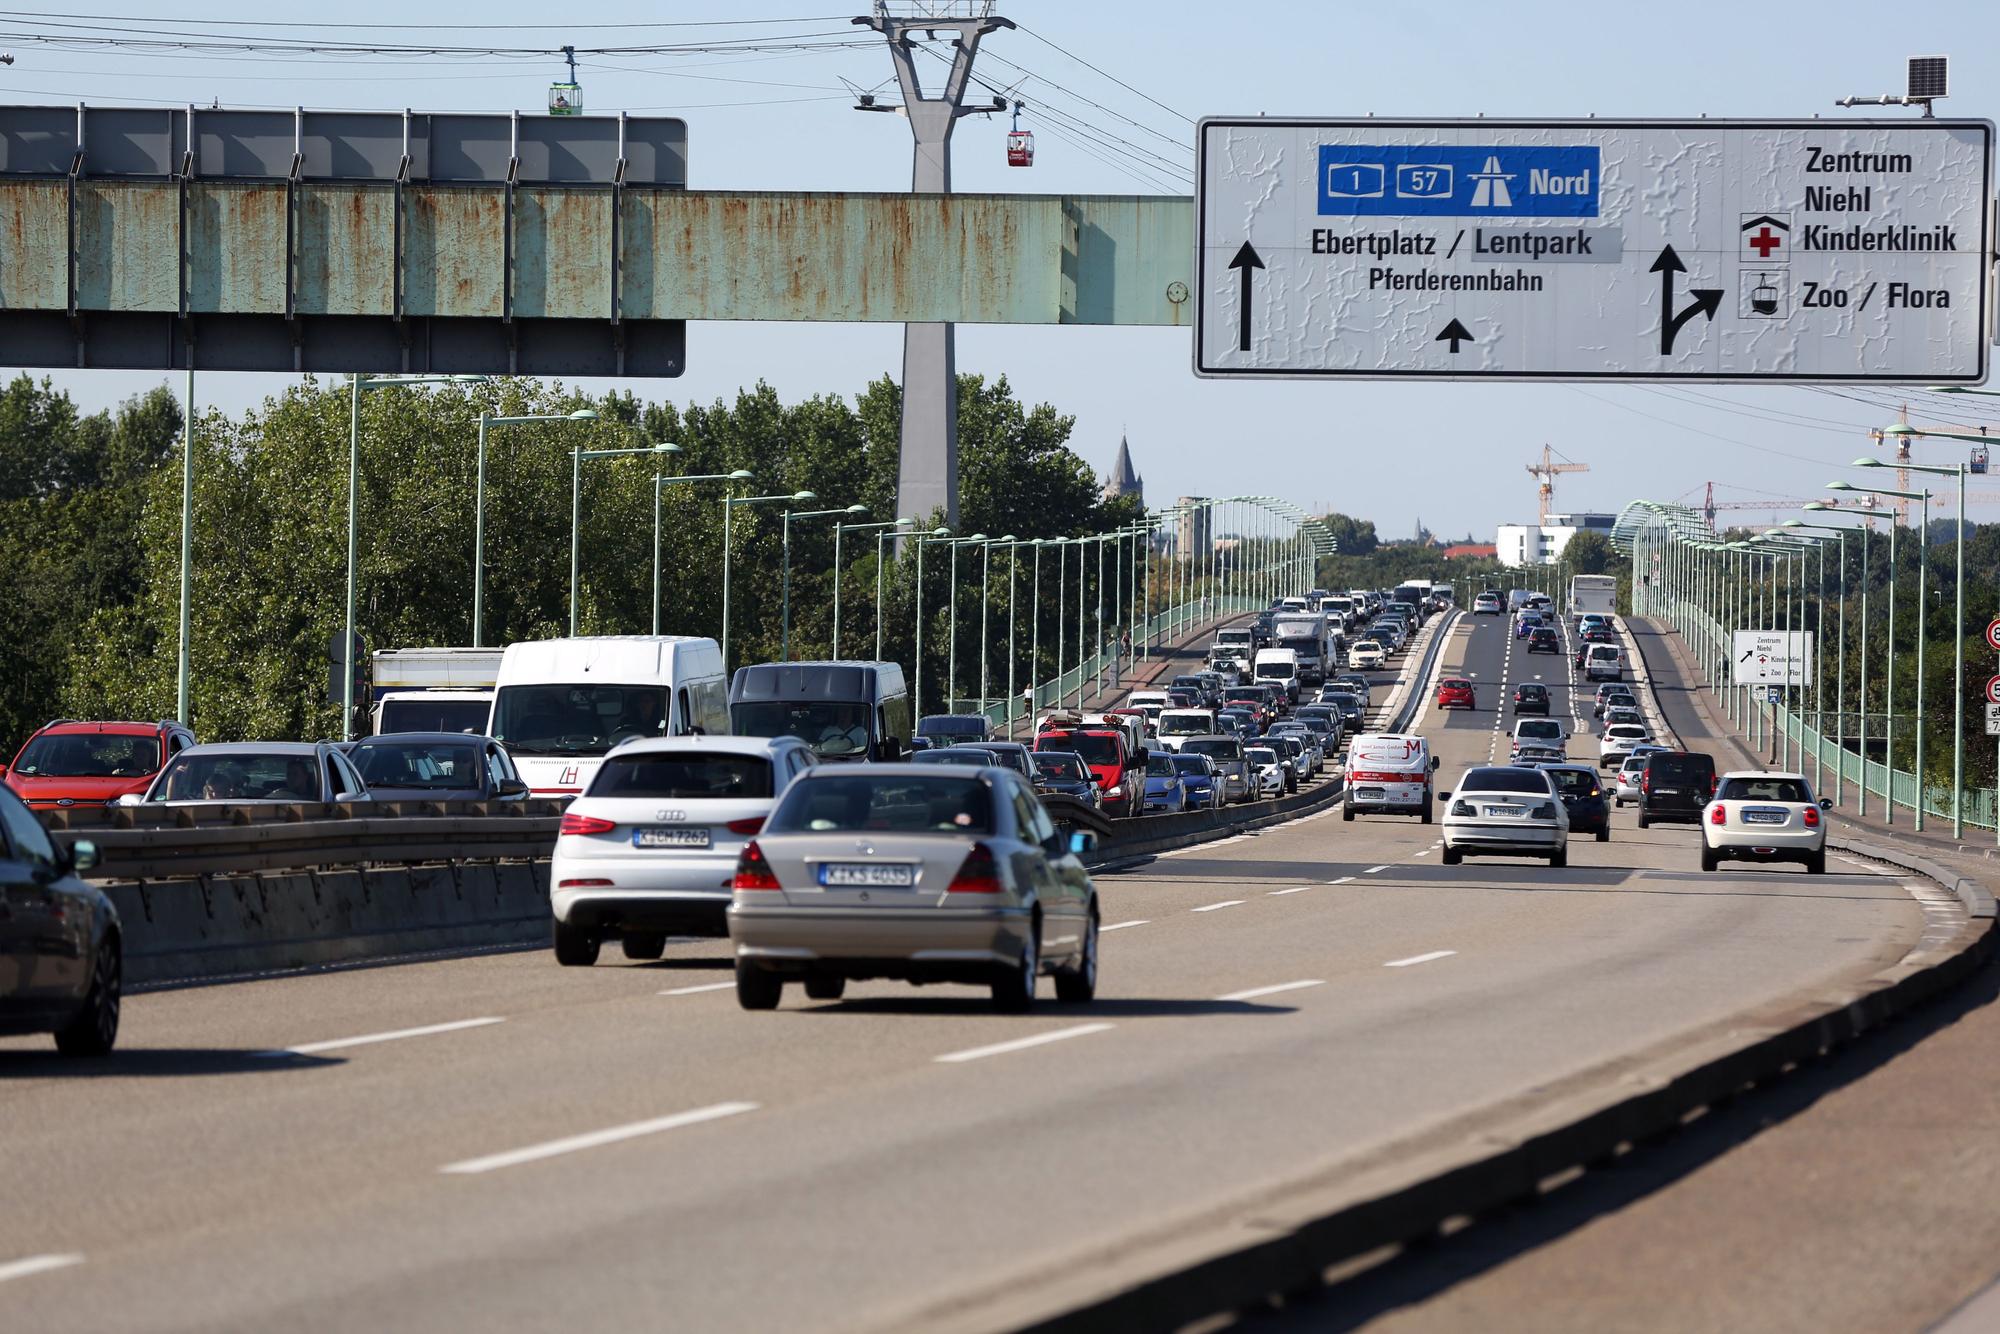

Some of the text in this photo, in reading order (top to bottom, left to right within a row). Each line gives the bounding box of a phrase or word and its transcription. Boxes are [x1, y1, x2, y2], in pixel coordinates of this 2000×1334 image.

[1806, 147, 1912, 173] Zentrum
[1350, 171, 1359, 190] 1
[1411, 171, 1437, 191] 57
[1530, 169, 1590, 195] Nord
[1806, 185, 1871, 212] Niehl
[1312, 229, 1593, 261] Ebertplatz / Lentpark
[1804, 224, 1957, 251] Kinderklinik
[1369, 267, 1543, 292] Pferderennbahn
[1803, 281, 1950, 312] Zoo / Flora
[677, 831, 706, 844] 7262
